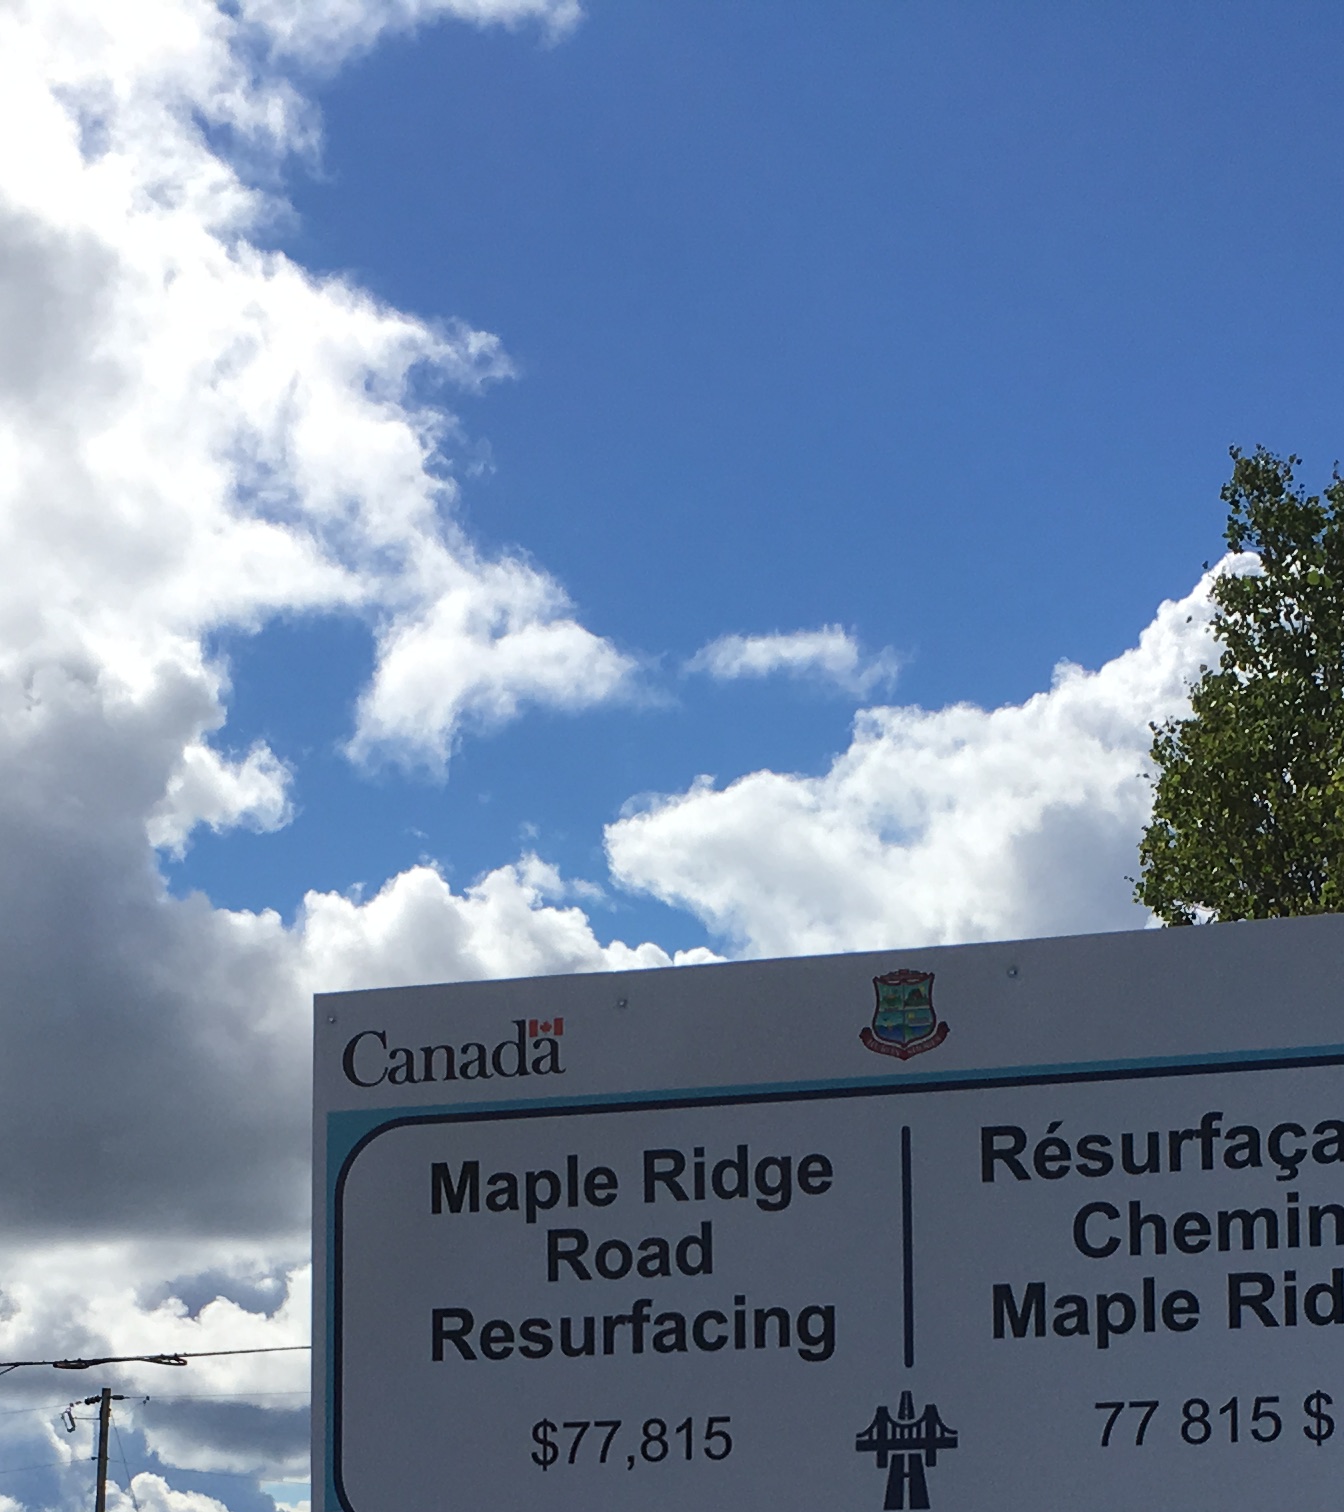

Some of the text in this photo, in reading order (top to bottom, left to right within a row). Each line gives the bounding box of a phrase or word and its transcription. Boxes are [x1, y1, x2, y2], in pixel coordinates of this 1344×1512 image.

[342, 1018, 566, 1088] Canada
[430, 1143, 834, 1225] Maple Ridge
[546, 1220, 714, 1283] Road
[431, 1294, 836, 1363] Resurfacing
[992, 1276, 1201, 1350] Maple
[530, 1415, 734, 1472] $77,815
[1094, 1389, 1336, 1448] 77 815 $
